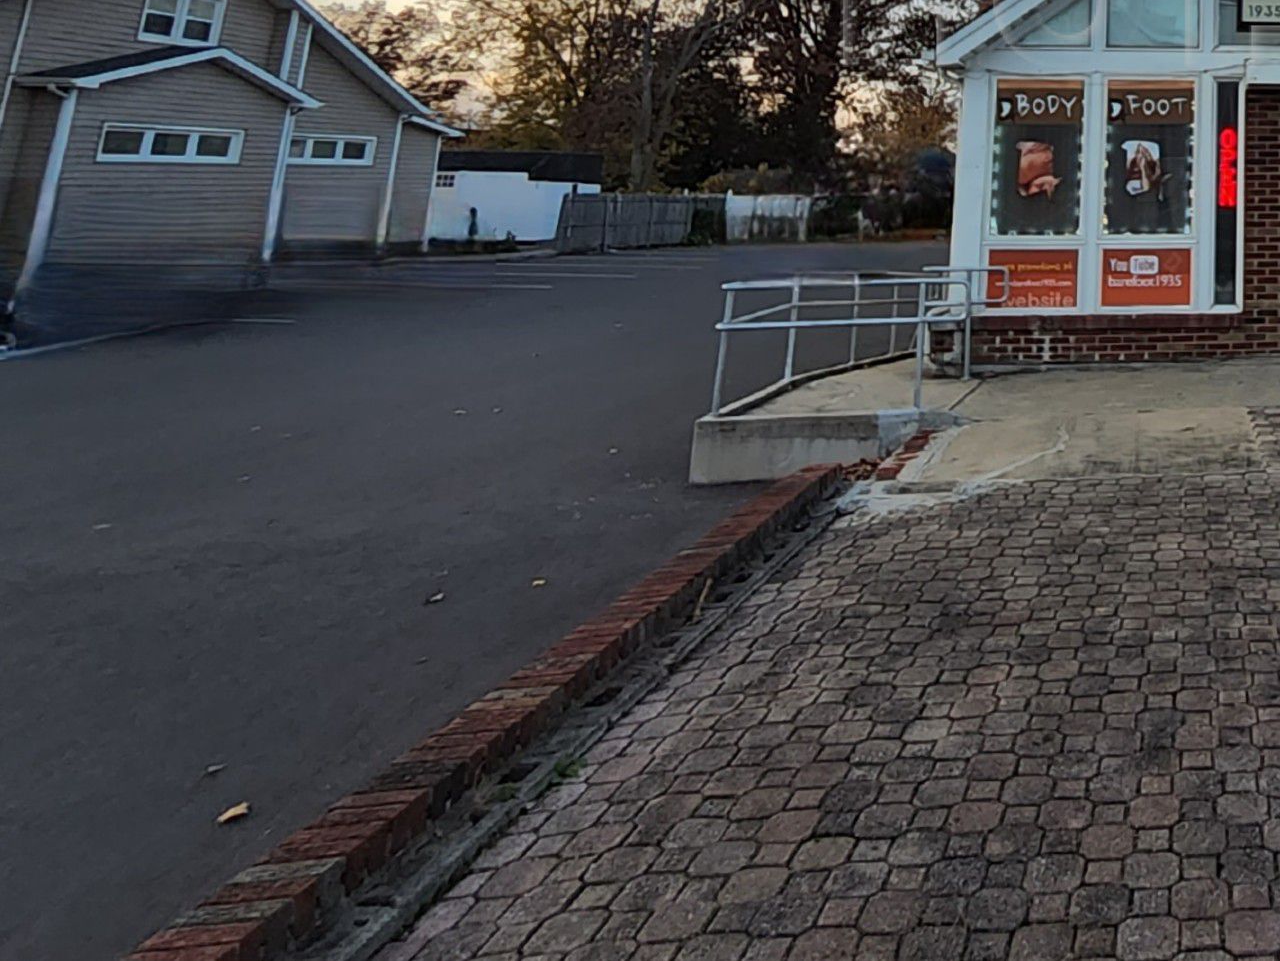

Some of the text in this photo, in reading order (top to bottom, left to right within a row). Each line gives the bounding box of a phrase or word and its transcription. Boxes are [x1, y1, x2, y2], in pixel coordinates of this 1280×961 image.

[1015, 94, 1077, 117] BODY
[1126, 95, 1188, 115] FOOT
[1219, 127, 1237, 207] OPEN
